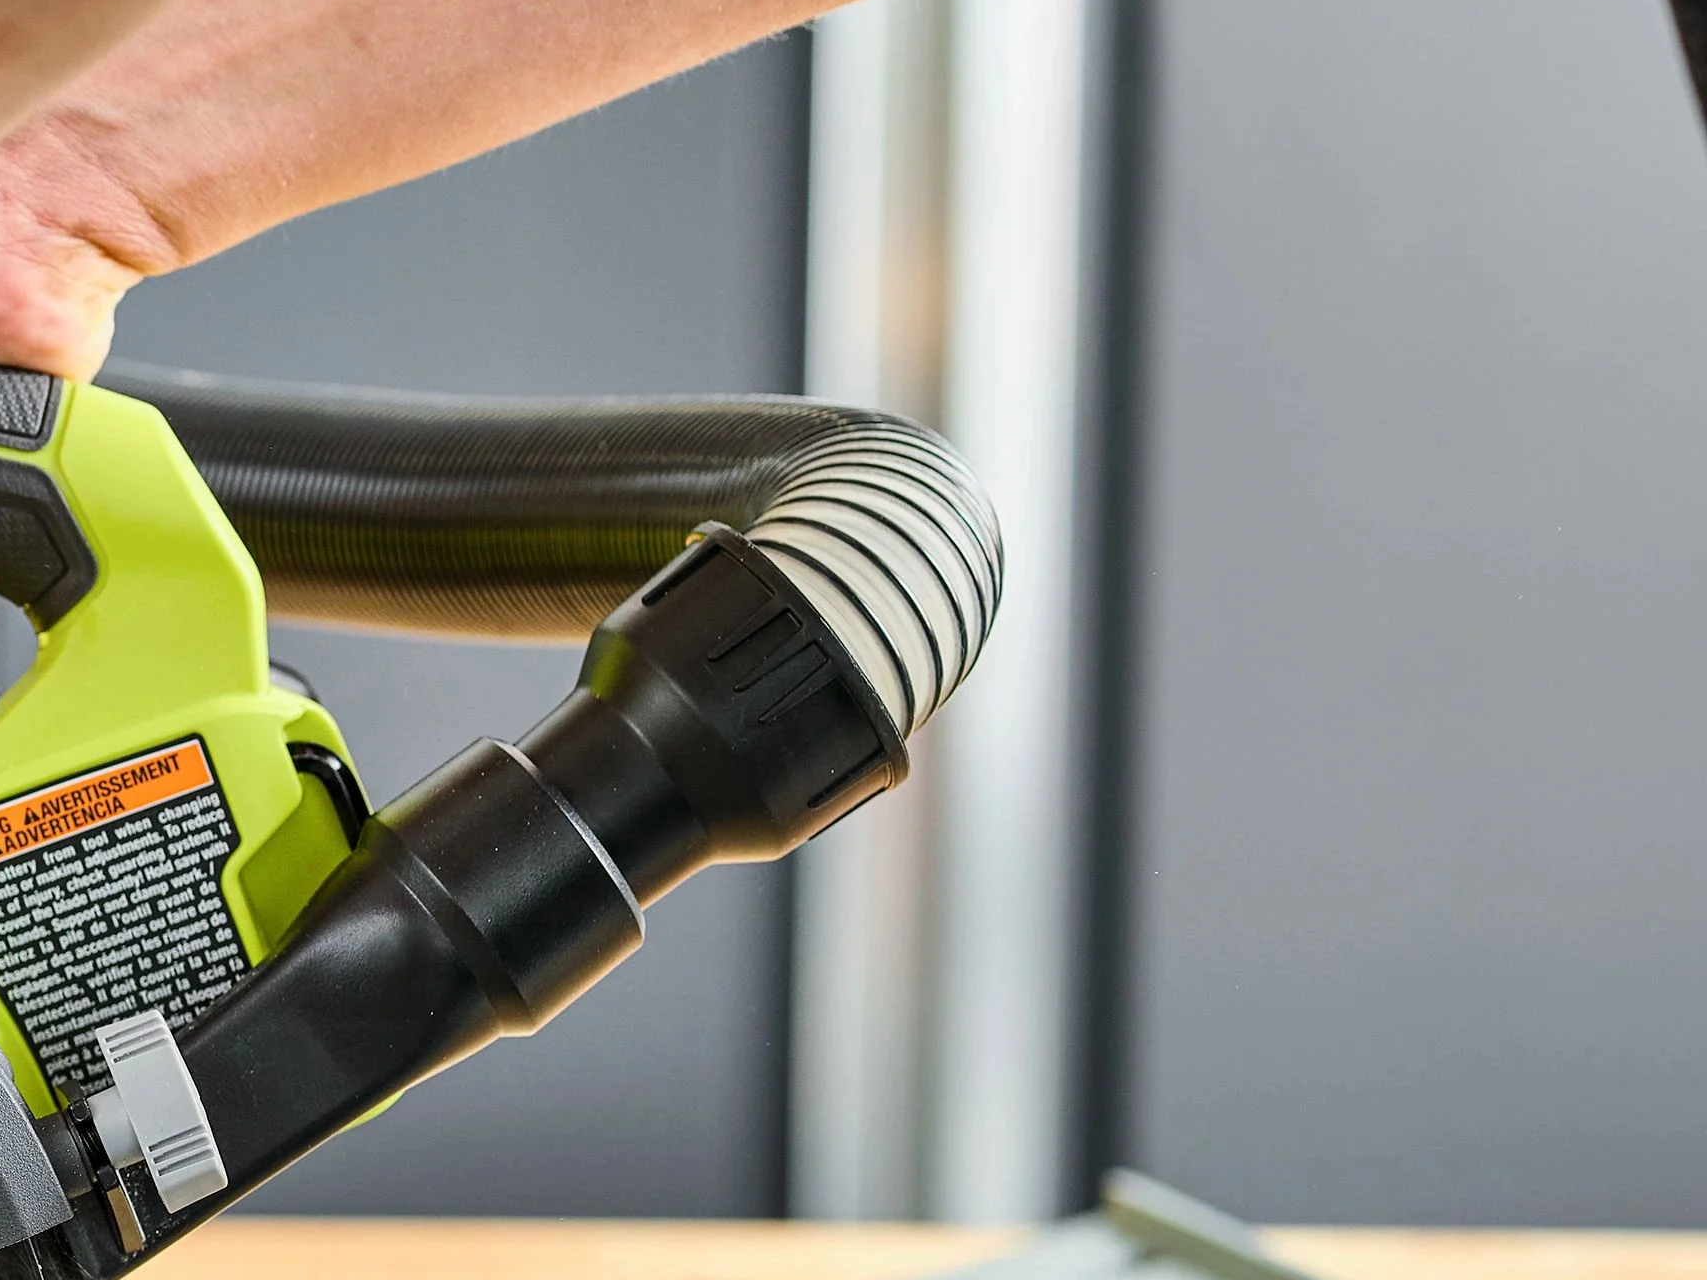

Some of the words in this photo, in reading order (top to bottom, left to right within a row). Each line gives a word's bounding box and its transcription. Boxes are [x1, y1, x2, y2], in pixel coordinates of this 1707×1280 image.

[41, 753, 179, 818] AVERTISSEMENT
[4, 796, 125, 852] ADVERTENCIA
[19, 877, 33, 891] or
[33, 860, 84, 885] making
[84, 831, 164, 868] adjustments.
[162, 823, 180, 838] To
[181, 807, 225, 832] reduce
[42, 845, 76, 865] from
[81, 830, 108, 851] tool
[114, 817, 152, 839] when
[158, 792, 220, 826] changing
[6, 896, 21, 914] of
[66, 868, 105, 892] check
[107, 847, 165, 879] guarding
[167, 829, 220, 855] system.
[6, 925, 51, 948] hands.
[50, 903, 102, 932] Support
[103, 893, 128, 913] and
[129, 881, 168, 903] clamp
[170, 867, 207, 888] work.
[31, 905, 53, 922] the
[52, 893, 88, 914] blade
[143, 859, 174, 881] Hold
[173, 851, 200, 870] saw
[200, 840, 229, 860] with
[38, 940, 54, 954] la
[58, 929, 85, 949] pile
[89, 920, 107, 936] de
[111, 902, 152, 927] l'outil
[156, 887, 195, 911] avant
[199, 880, 216, 895] de
[50, 950, 74, 968] des
[75, 923, 148, 958] accessoires
[148, 916, 166, 931] ou
[166, 905, 196, 924] faire
[197, 896, 221, 913] des
[64, 960, 93, 979] Pour
[140, 935, 162, 951] les
[162, 918, 209, 944] risques
[209, 911, 227, 926] de
[24, 997, 95, 1030] protection.
[110, 977, 137, 997] doit
[139, 961, 184, 987] couvrir
[187, 955, 203, 969] la
[204, 943, 238, 963] lame
[86, 963, 133, 988] vérifier
[137, 956, 152, 970] le
[215, 927, 232, 942] de
[138, 983, 172, 1003] Tenir
[175, 977, 190, 991] la
[198, 964, 226, 983] scie
